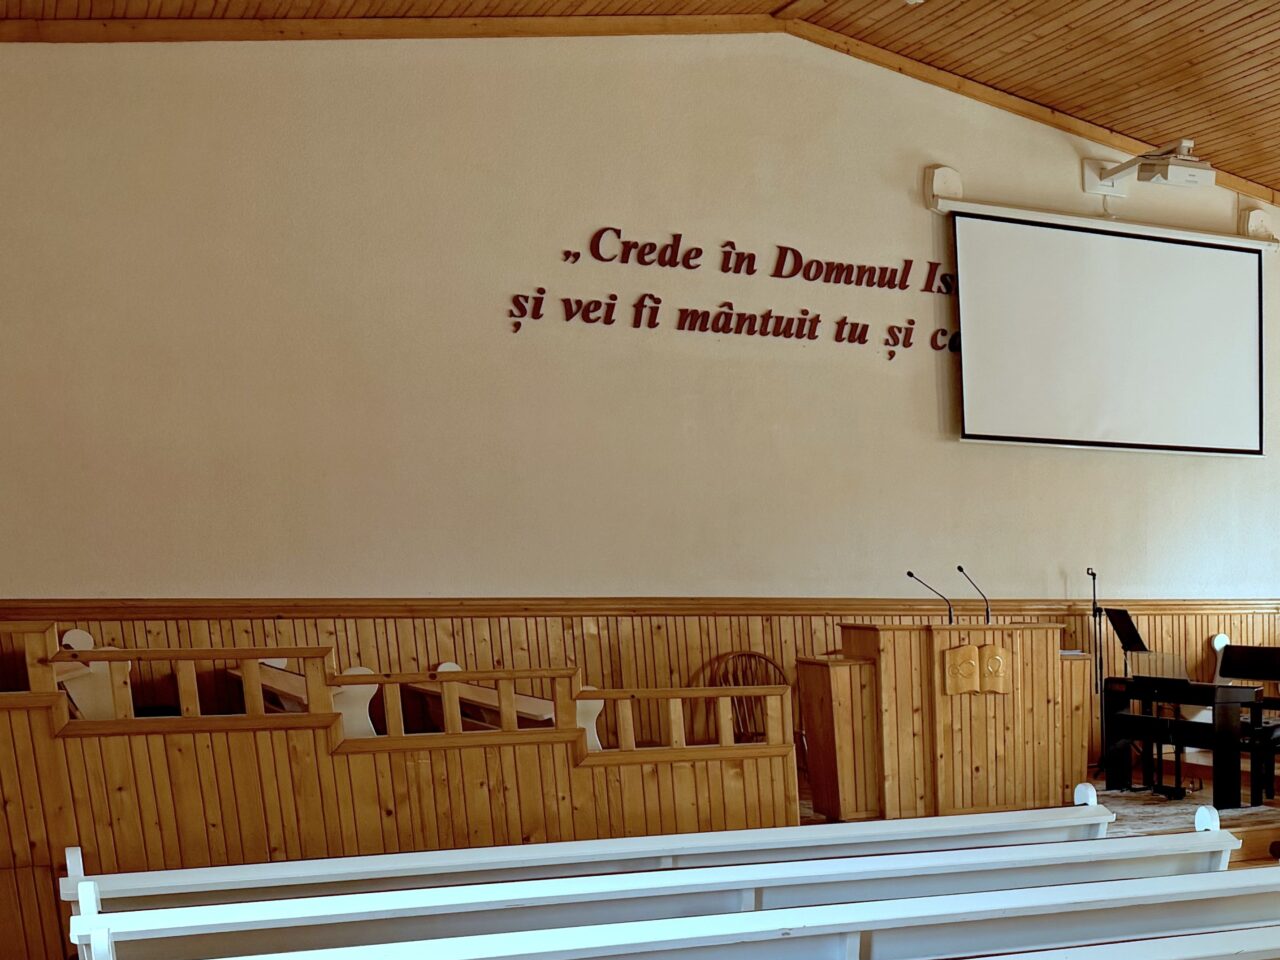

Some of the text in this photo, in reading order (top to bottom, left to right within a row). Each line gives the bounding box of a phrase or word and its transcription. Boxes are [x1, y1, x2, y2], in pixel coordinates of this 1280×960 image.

[719, 241, 757, 276] în
[770, 246, 912, 291] Domnul
[508, 287, 546, 333] și
[560, 293, 617, 326] vei
[631, 293, 662, 329] fi
[676, 301, 821, 342] mântuit
[833, 315, 869, 345] tu
[884, 319, 915, 360] și
